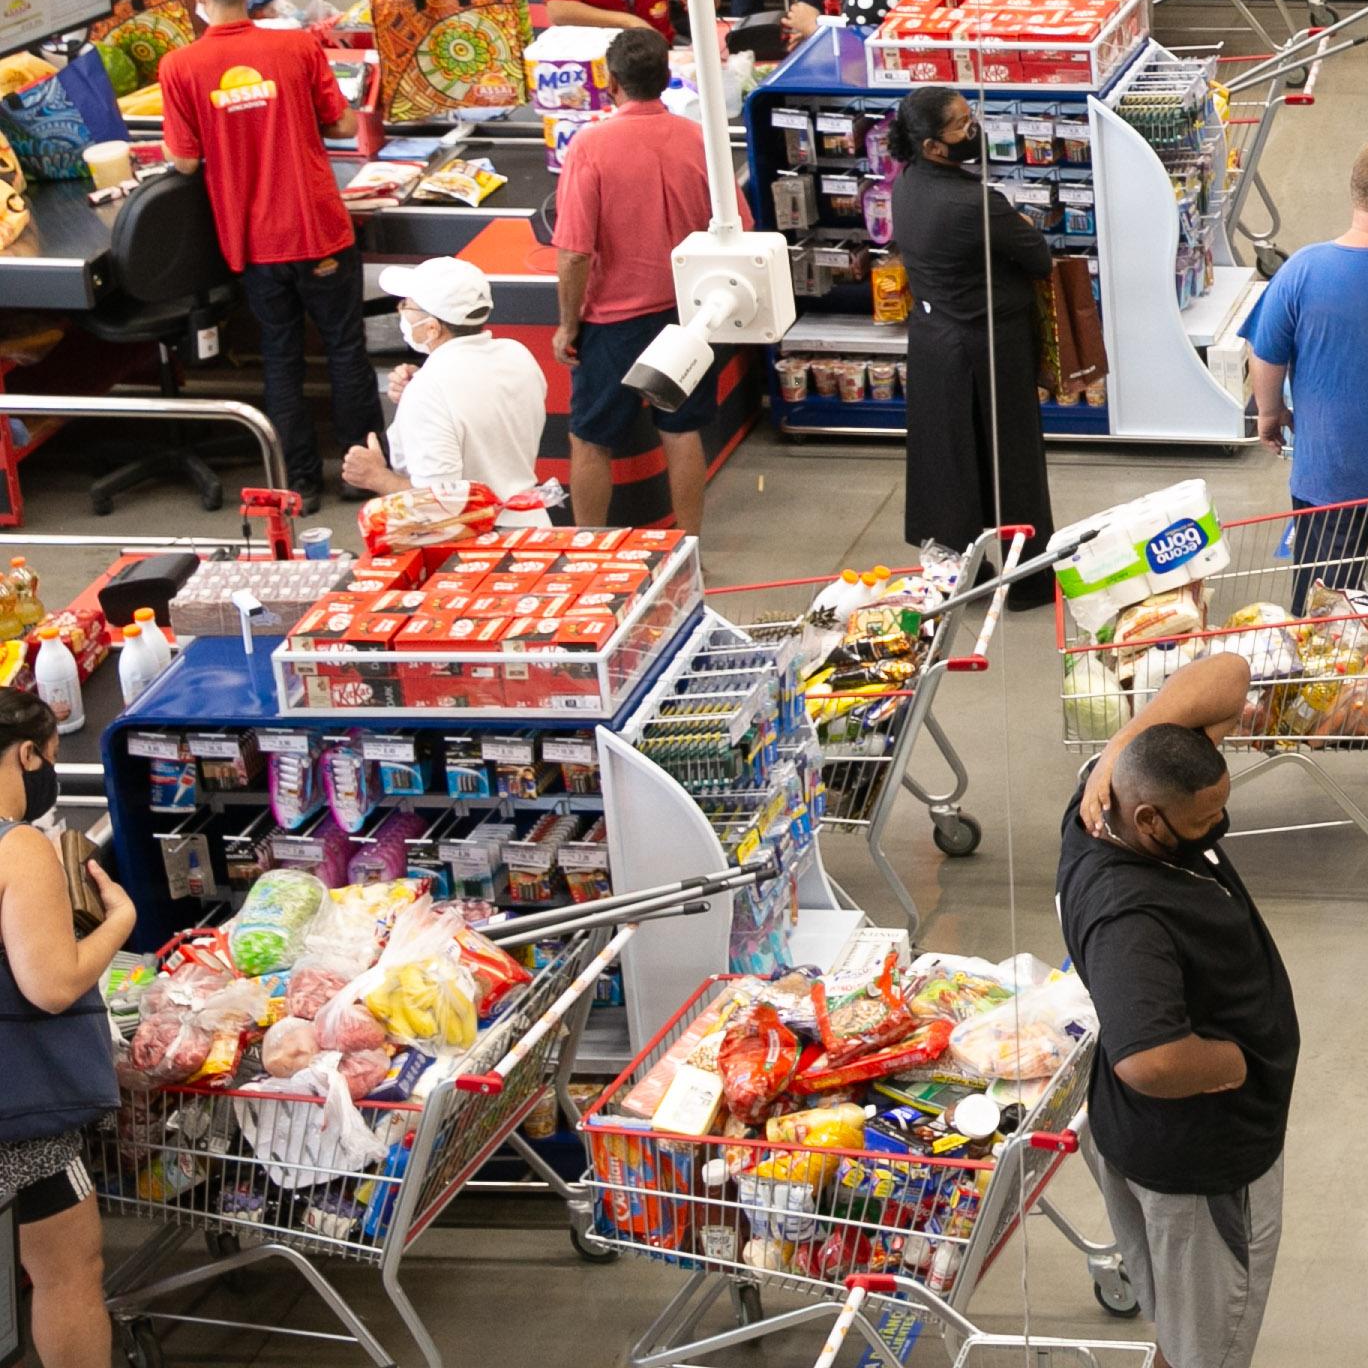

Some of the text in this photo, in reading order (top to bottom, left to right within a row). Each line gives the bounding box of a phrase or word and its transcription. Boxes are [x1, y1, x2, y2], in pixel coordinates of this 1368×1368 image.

[538, 67, 584, 91] Max
[1151, 527, 1202, 555] bom
[1156, 541, 1197, 564] econo
